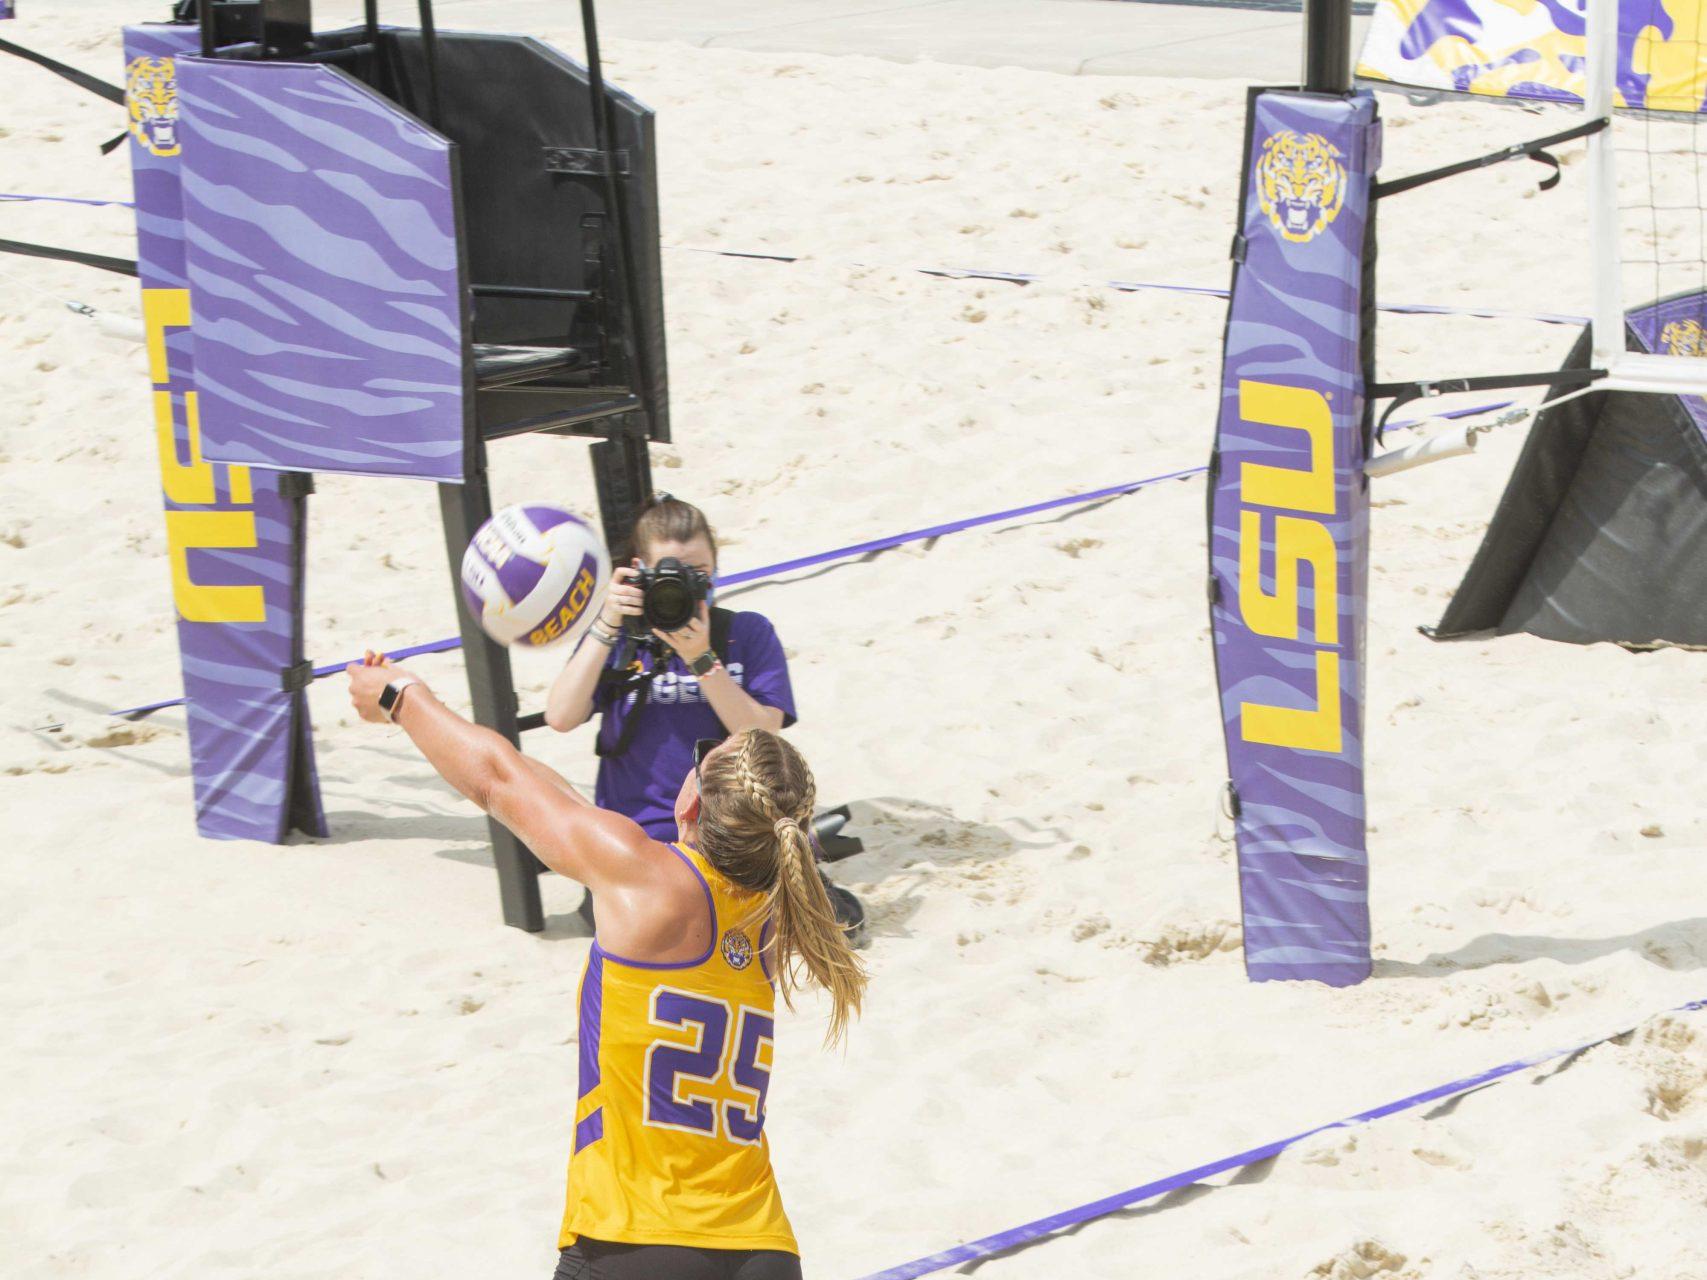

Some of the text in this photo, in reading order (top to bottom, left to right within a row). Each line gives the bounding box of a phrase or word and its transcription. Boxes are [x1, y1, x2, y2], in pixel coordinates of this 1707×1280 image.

[141, 289, 266, 622] LSU
[1239, 379, 1342, 753] LSU
[528, 567, 596, 646] BEACH
[642, 984, 775, 1147] 25
